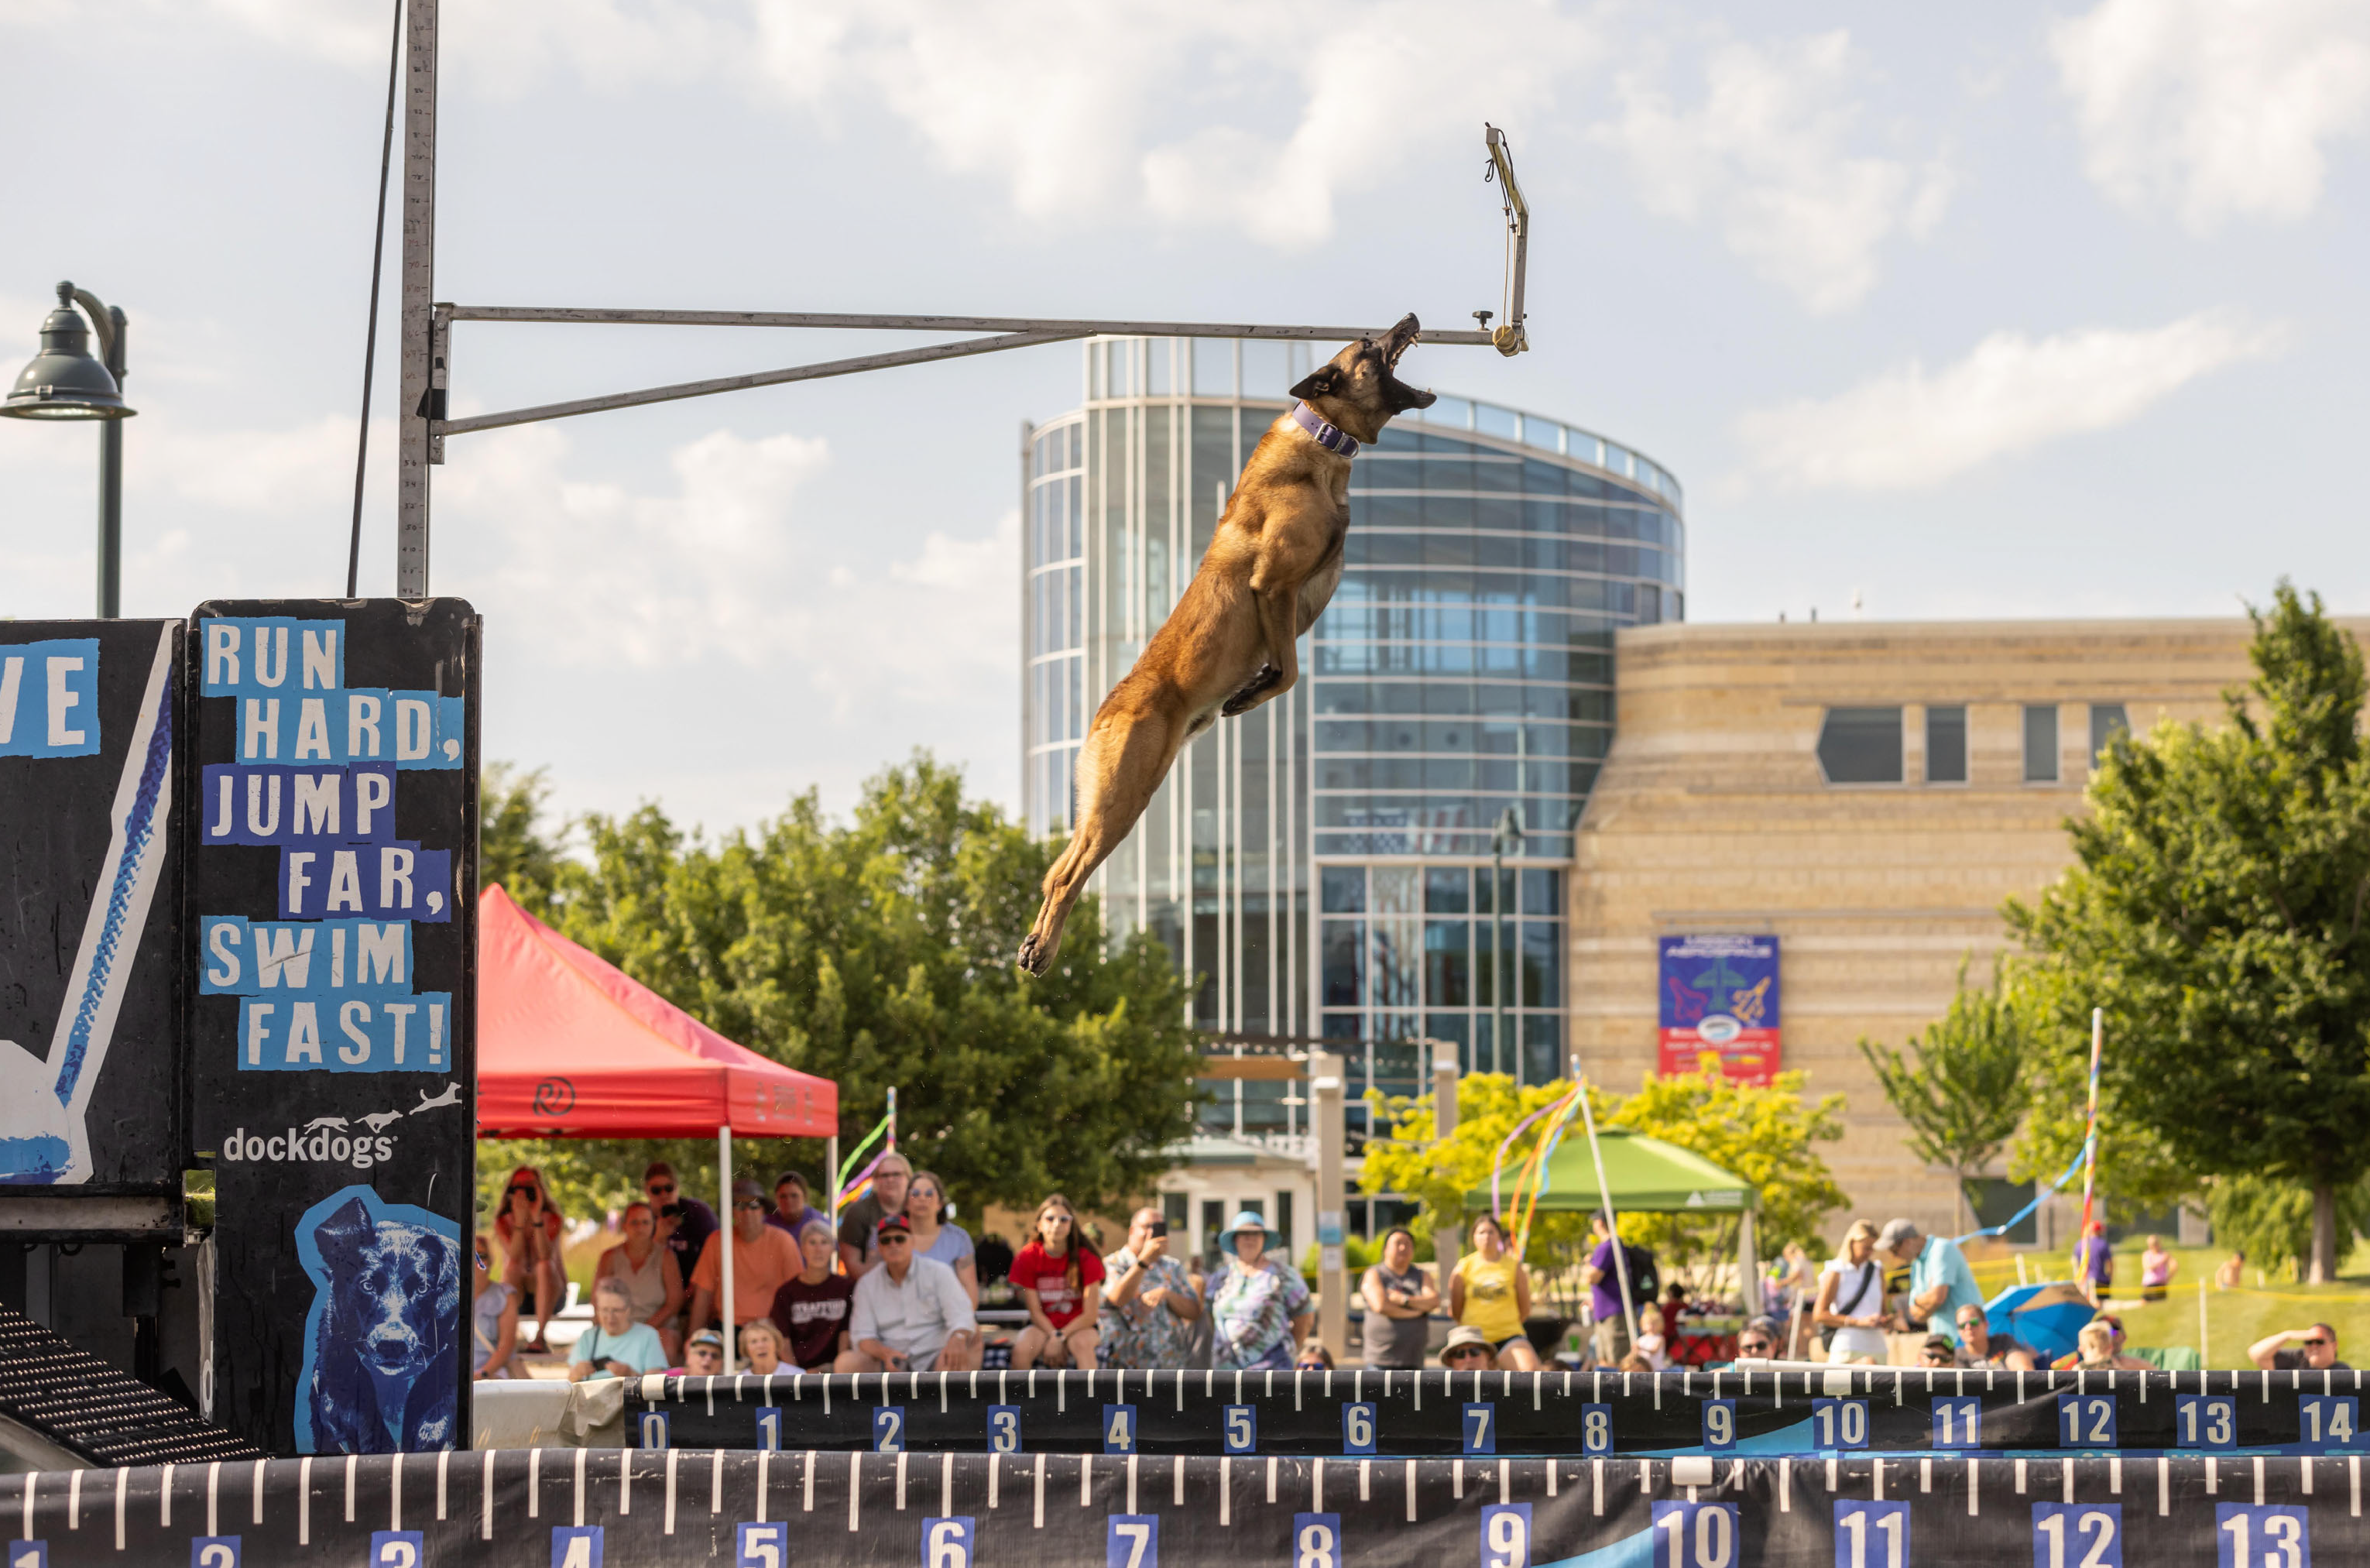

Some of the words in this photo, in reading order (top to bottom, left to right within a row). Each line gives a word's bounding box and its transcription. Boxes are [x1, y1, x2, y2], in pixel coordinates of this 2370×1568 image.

[208, 624, 336, 690] RUN
[244, 695, 460, 762] HARD,
[211, 772, 390, 836] JUMP
[288, 847, 444, 914] FAR,
[208, 922, 406, 989] SWIM
[248, 1000, 444, 1065] FAST!
[644, 1415, 665, 1449] 0
[760, 1415, 777, 1450] 1
[880, 1412, 900, 1451] 2
[994, 1412, 1017, 1452] 3
[1107, 1411, 1131, 1450] 4
[1228, 1408, 1251, 1448] 5
[1347, 1406, 1372, 1447] 6
[1467, 1409, 1490, 1448] 7
[1586, 1411, 1608, 1451] 8
[1708, 1405, 1733, 1445] 9
[1816, 1402, 1865, 1445] 10
[1936, 1403, 1977, 1444] 11
[2063, 1400, 2111, 1442] 12
[2180, 1401, 2231, 1444] 13
[2303, 1401, 2353, 1443] 14
[743, 1527, 780, 1568] 5
[928, 1521, 967, 1568] 6
[1115, 1523, 1150, 1568] 7
[1298, 1524, 1334, 1568] 8
[1487, 1511, 1526, 1568] 9
[1657, 1505, 1731, 1568] 10
[1839, 1510, 1903, 1568] 11
[2037, 1511, 2115, 1568] 12
[2221, 1513, 2302, 1568] 13
